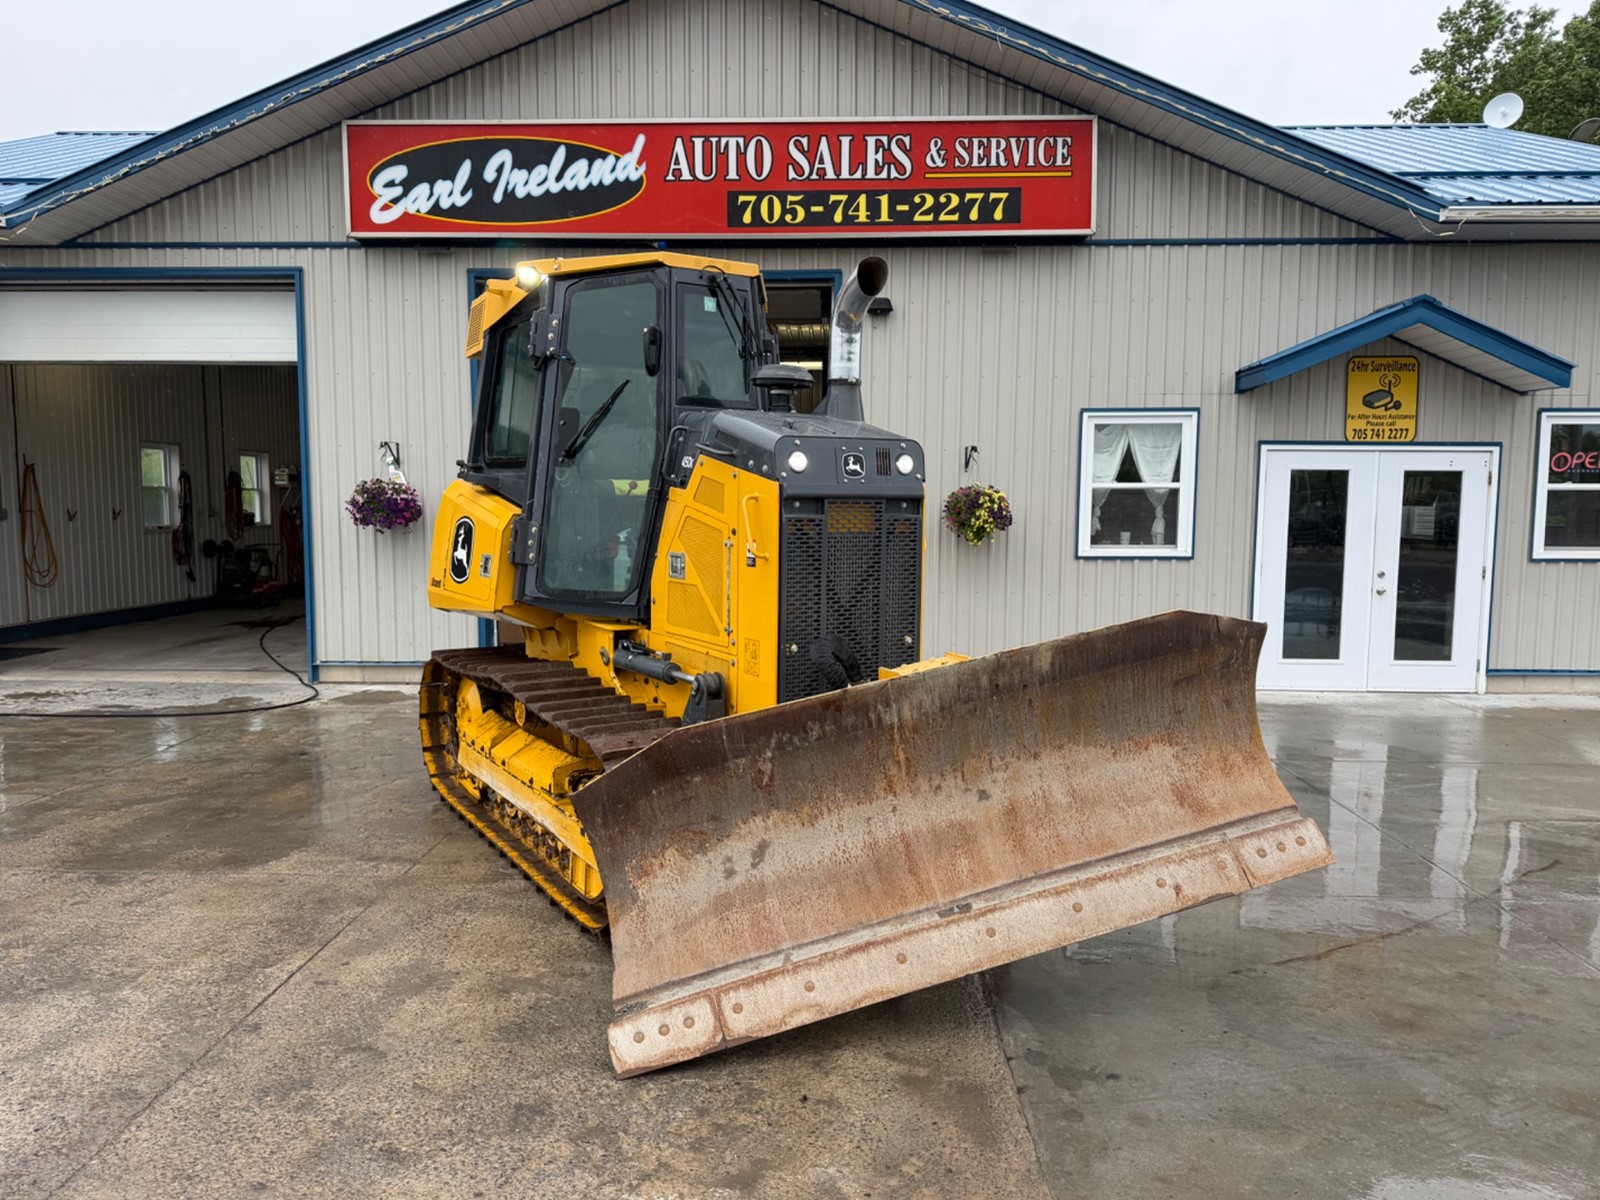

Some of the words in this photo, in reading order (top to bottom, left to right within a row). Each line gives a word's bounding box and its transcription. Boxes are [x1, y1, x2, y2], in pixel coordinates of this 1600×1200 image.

[664, 134, 773, 182] AUTO
[786, 133, 912, 182] SALES
[924, 137, 948, 169] &
[953, 136, 1073, 168] SERVICE
[370, 158, 473, 224] Earl
[483, 133, 647, 204] Ireland
[736, 191, 1010, 224] 705-741-2277
[1351, 360, 1369, 373] 24hr
[1370, 360, 1416, 373] Surveillance
[1352, 428, 1368, 440] 705
[1369, 428, 1386, 440] 741
[1387, 428, 1409, 440] 2277
[1551, 451, 1600, 472] OPE
